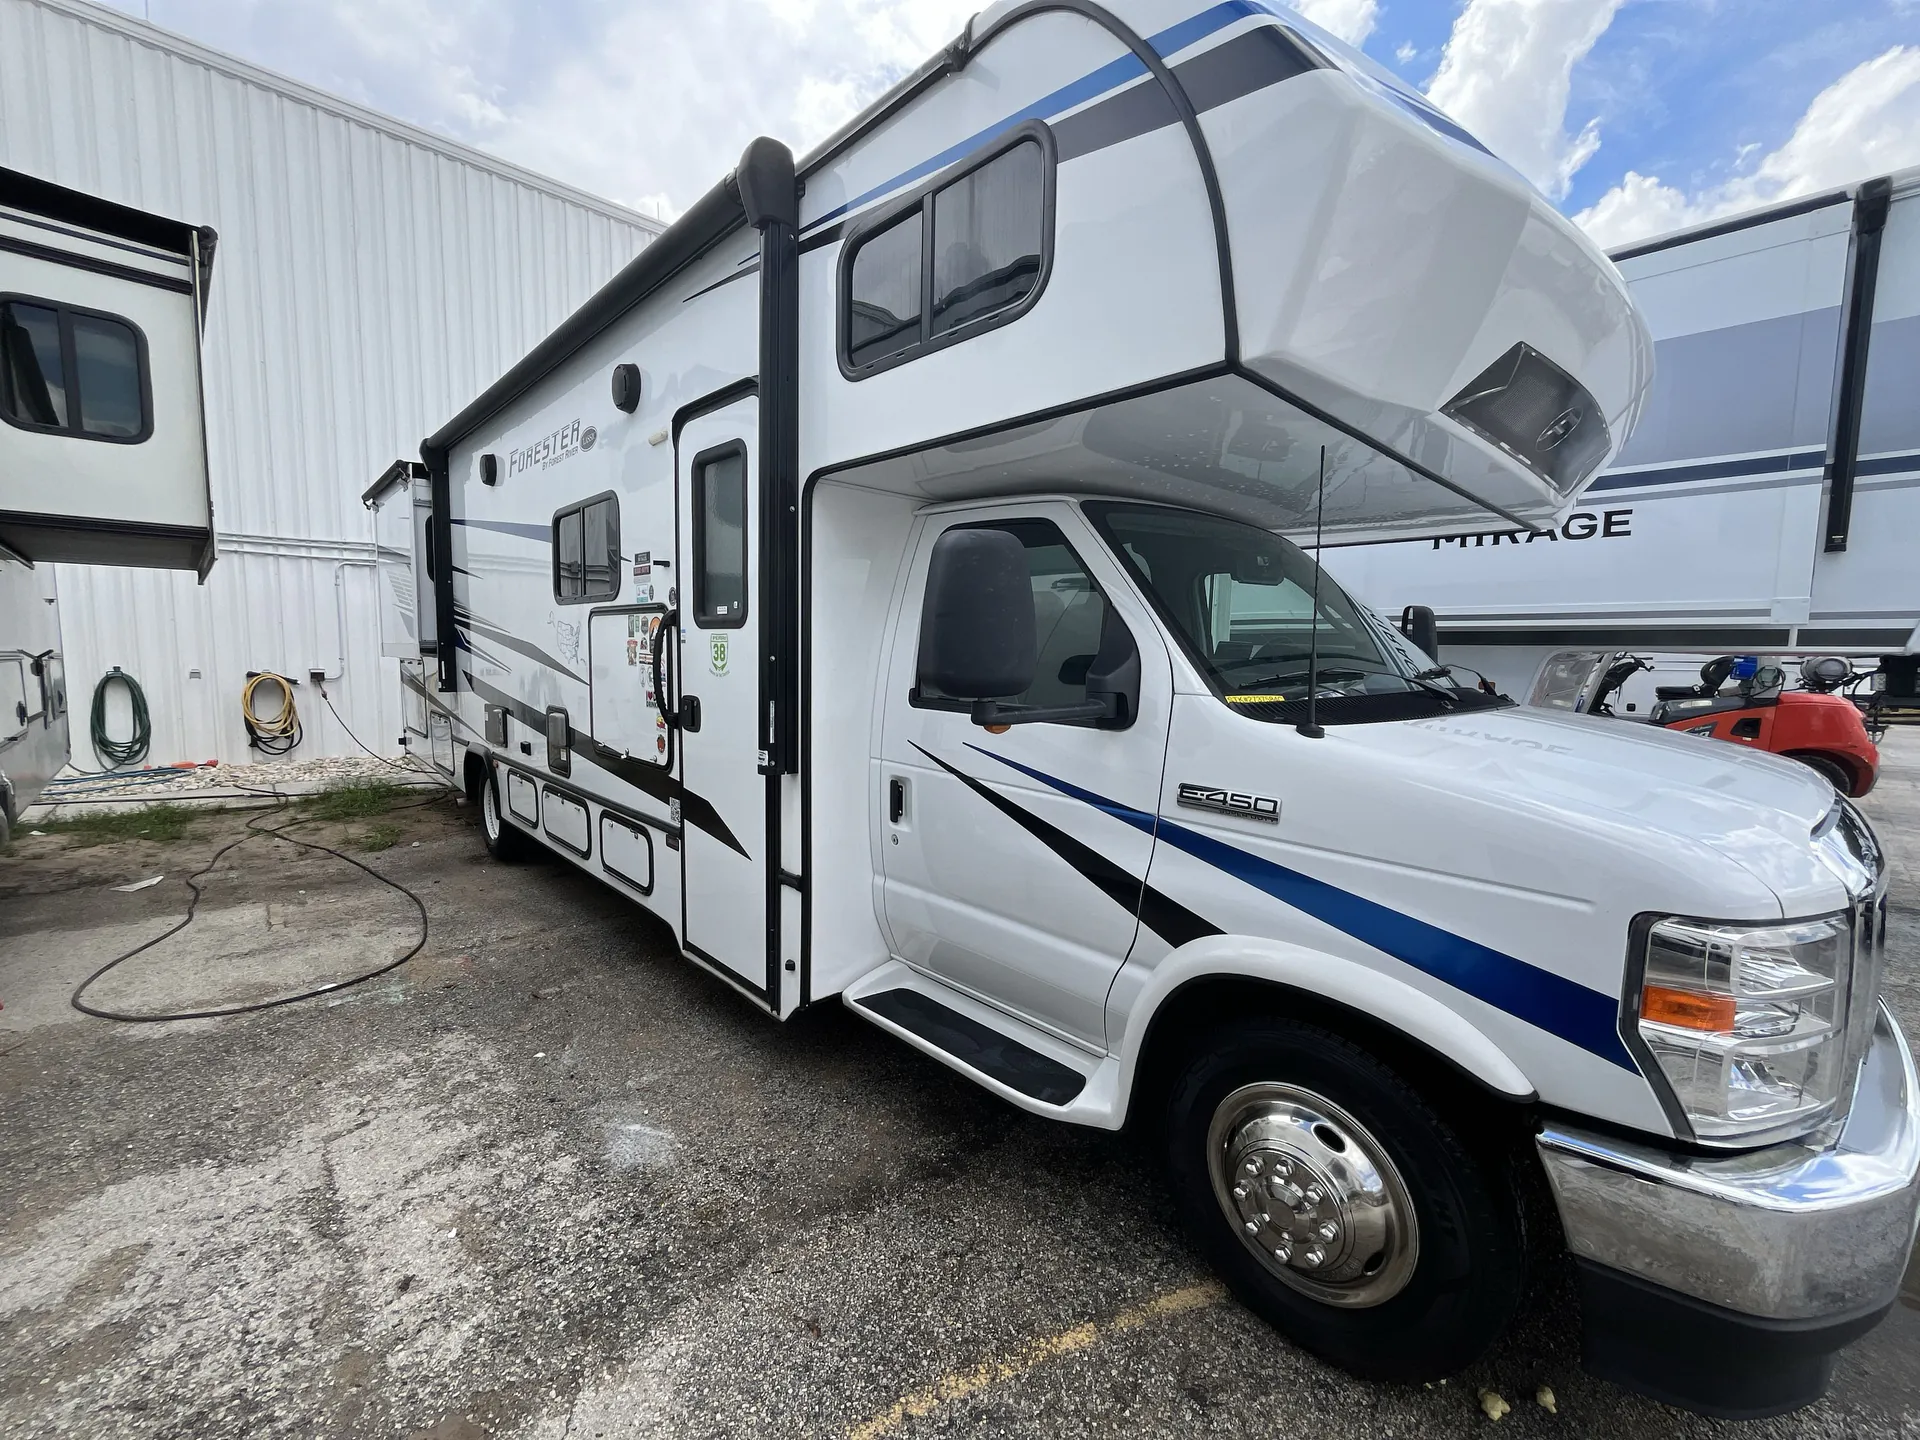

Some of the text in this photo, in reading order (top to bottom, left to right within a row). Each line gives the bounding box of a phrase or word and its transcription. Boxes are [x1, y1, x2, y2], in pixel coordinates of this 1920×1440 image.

[509, 418, 580, 478] FORESTER
[549, 452, 565, 467] FOREST
[565, 446, 579, 459] RIVER
[713, 643, 725, 661] 38
[1179, 786, 1278, 814] E-450
